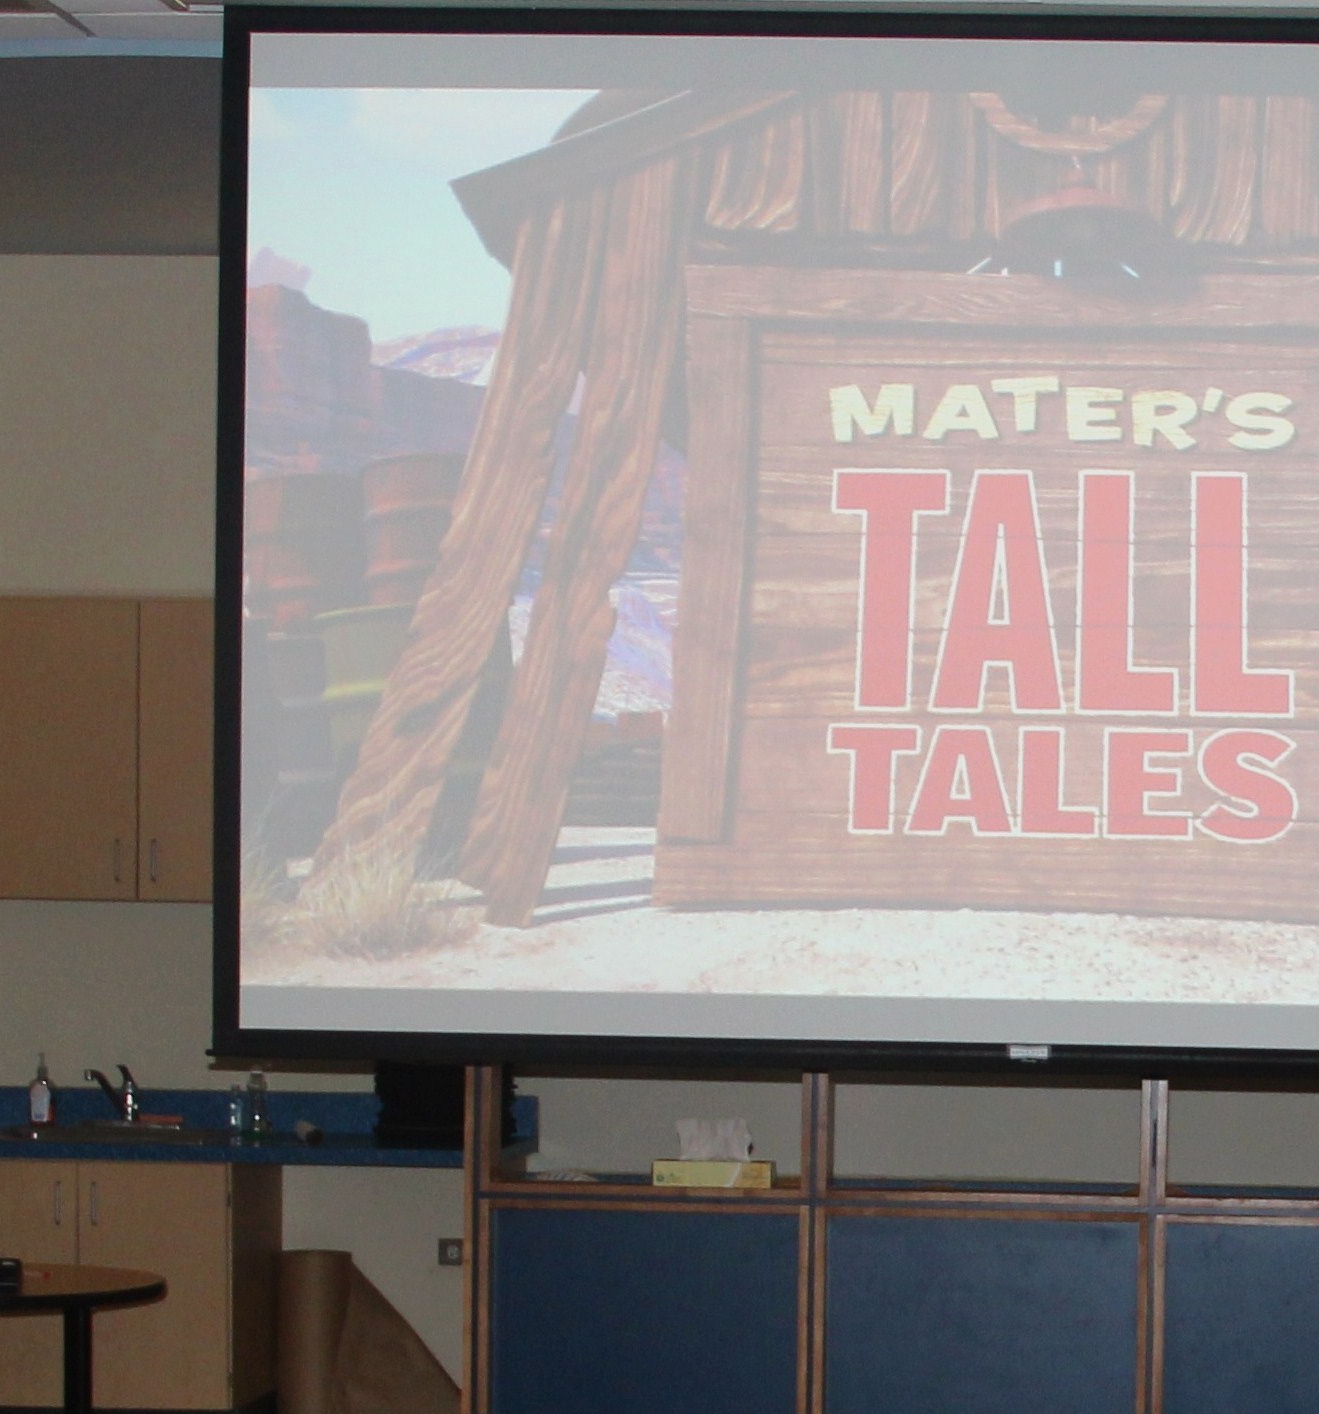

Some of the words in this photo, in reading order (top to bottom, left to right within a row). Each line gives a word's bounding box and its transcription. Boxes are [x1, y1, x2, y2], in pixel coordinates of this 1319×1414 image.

[828, 375, 1297, 452] MATER'S
[831, 468, 1295, 718] TALL
[827, 723, 1299, 844] TALES
